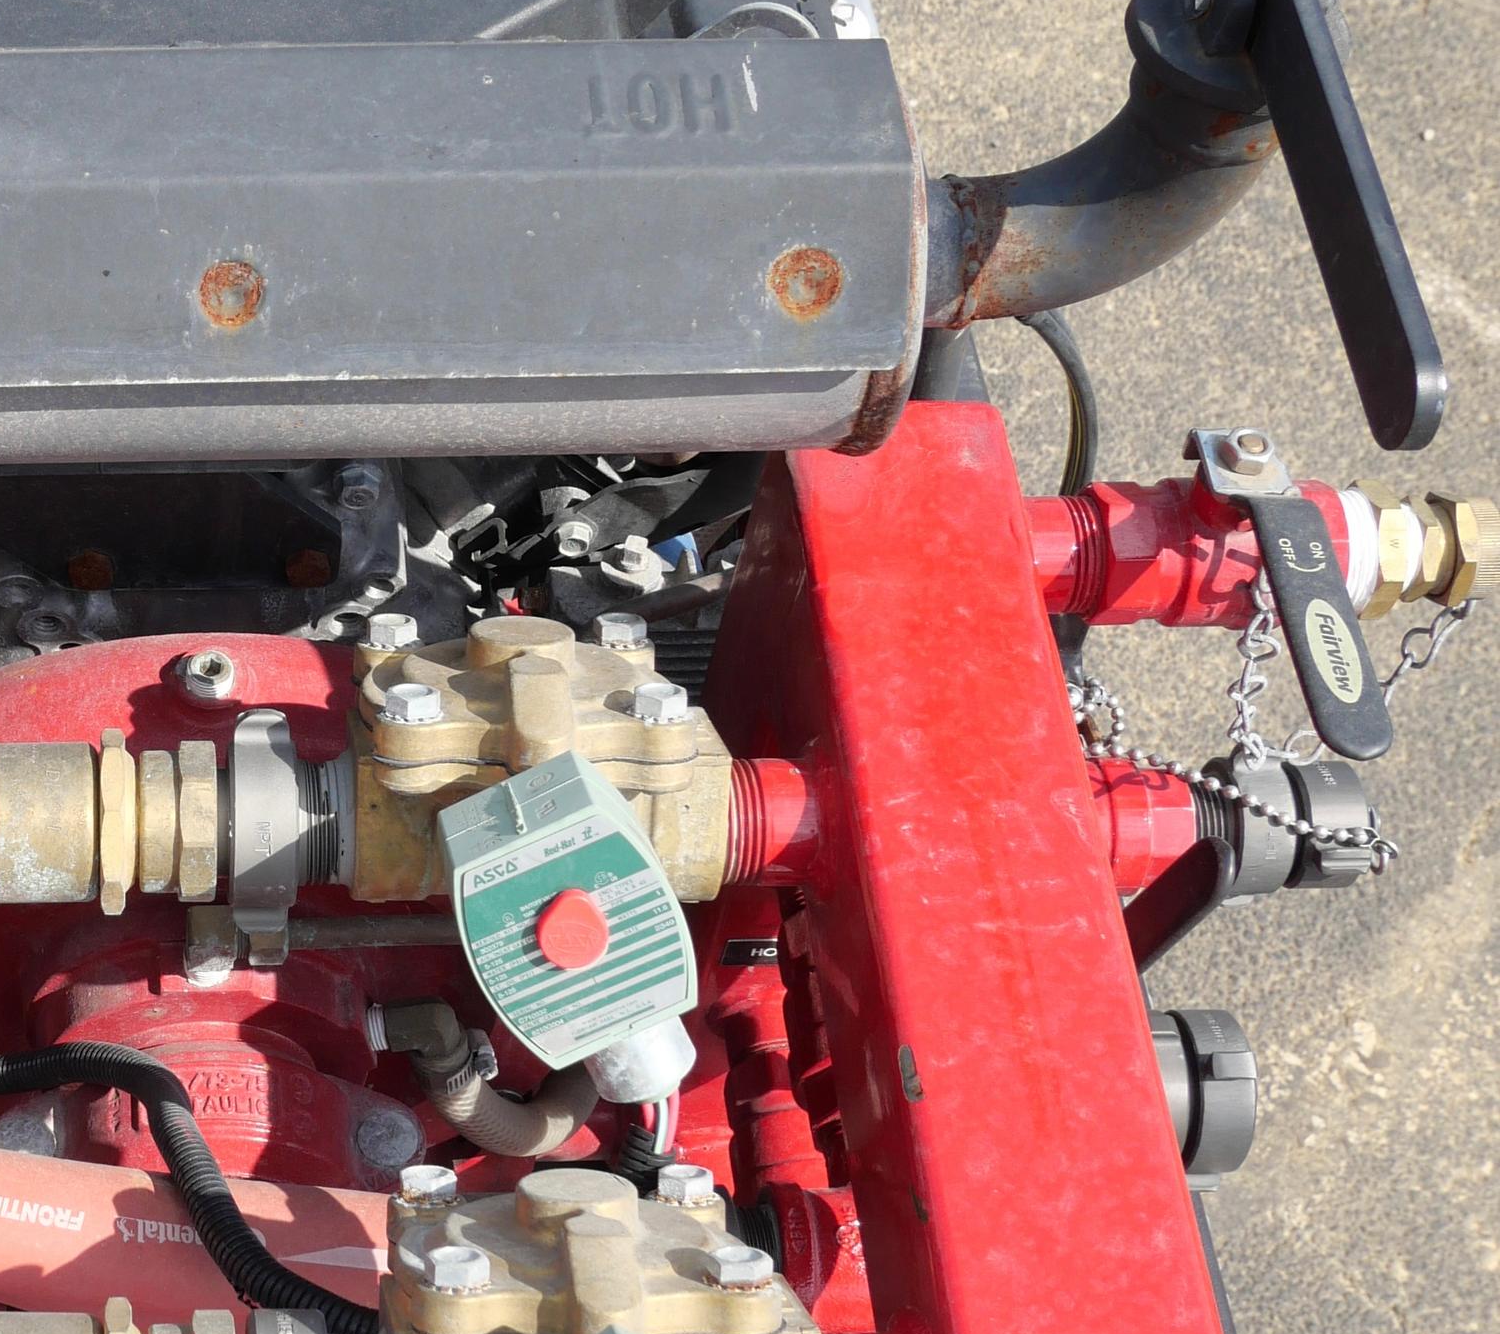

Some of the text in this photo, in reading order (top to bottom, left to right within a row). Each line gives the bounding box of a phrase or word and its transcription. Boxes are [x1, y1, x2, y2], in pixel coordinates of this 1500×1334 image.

[1278, 536, 1296, 563] OFF
[1308, 540, 1325, 560] ON
[1313, 607, 1355, 697] Fairview
